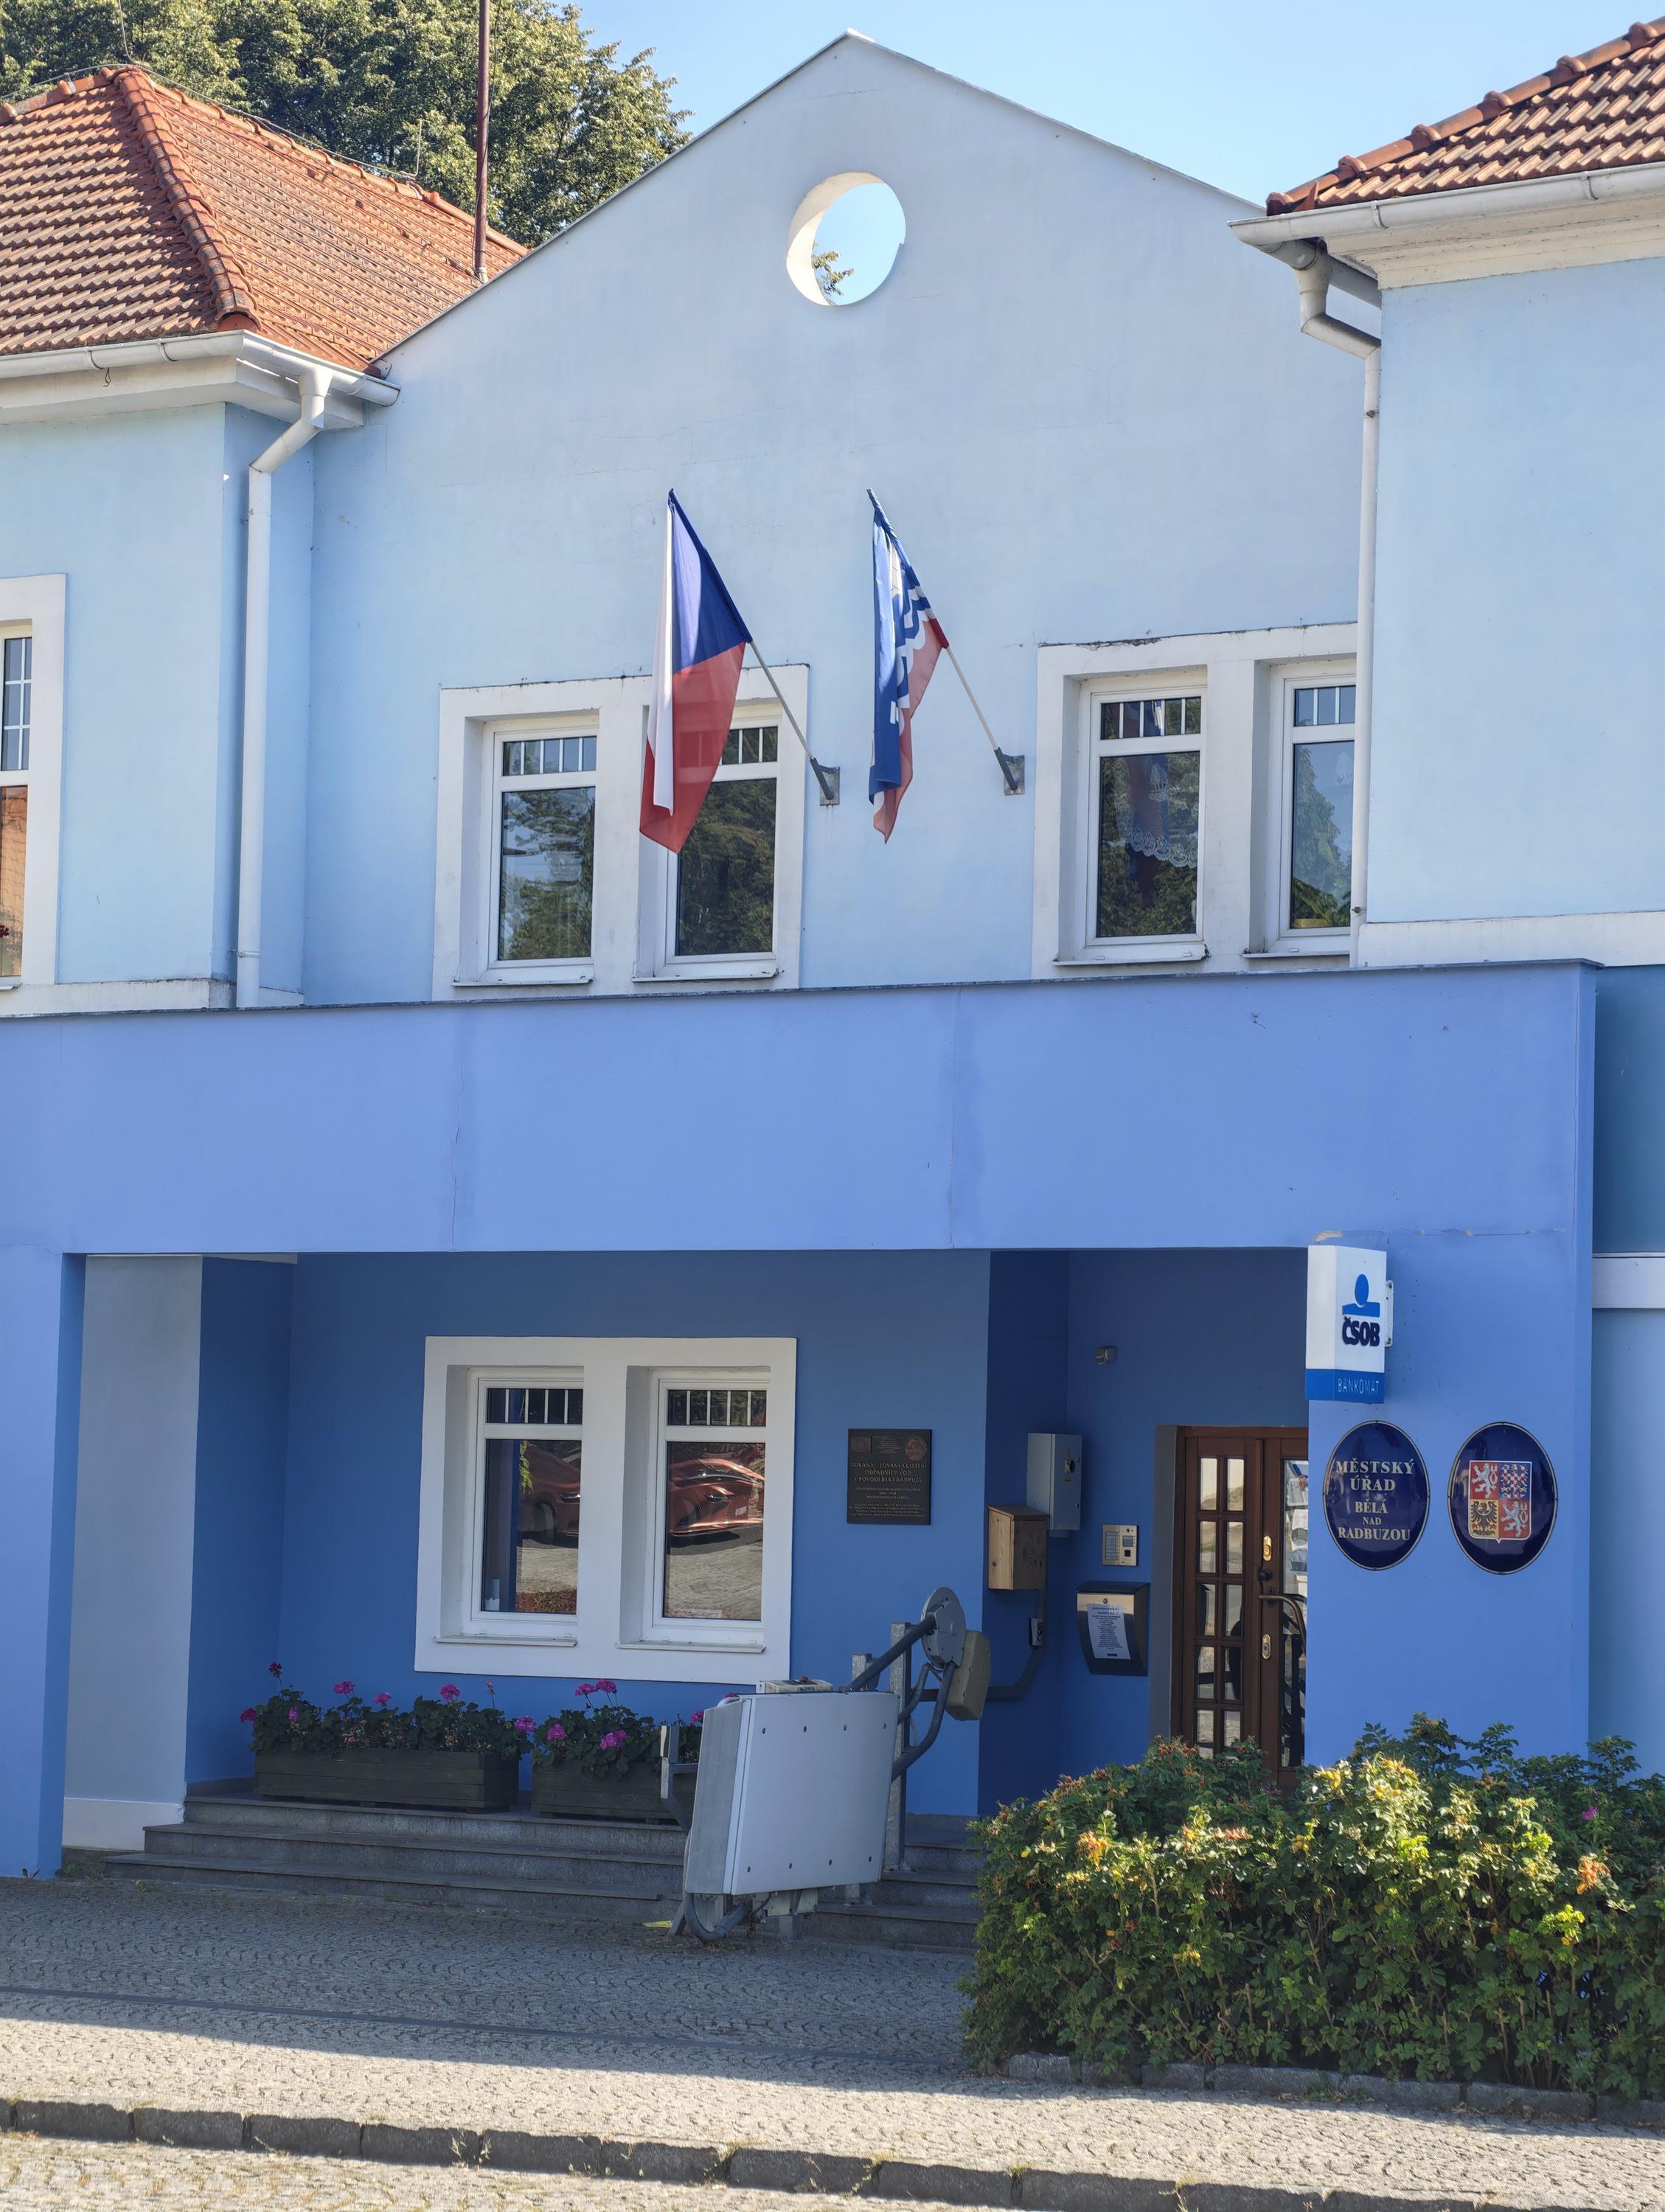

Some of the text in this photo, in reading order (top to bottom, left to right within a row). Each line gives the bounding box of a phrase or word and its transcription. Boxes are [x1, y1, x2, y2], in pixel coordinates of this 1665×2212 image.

[1342, 1316, 1380, 1346] ČSOB
[1338, 1377, 1379, 1396] BANKOMAT
[1335, 1457, 1415, 1474] MĚSTSKÝ
[1350, 1474, 1396, 1491] ÚŘAD
[1355, 1498, 1388, 1514] BĚLÁ
[1363, 1517, 1382, 1525] NAD
[1338, 1527, 1411, 1540] RADBUZOU
